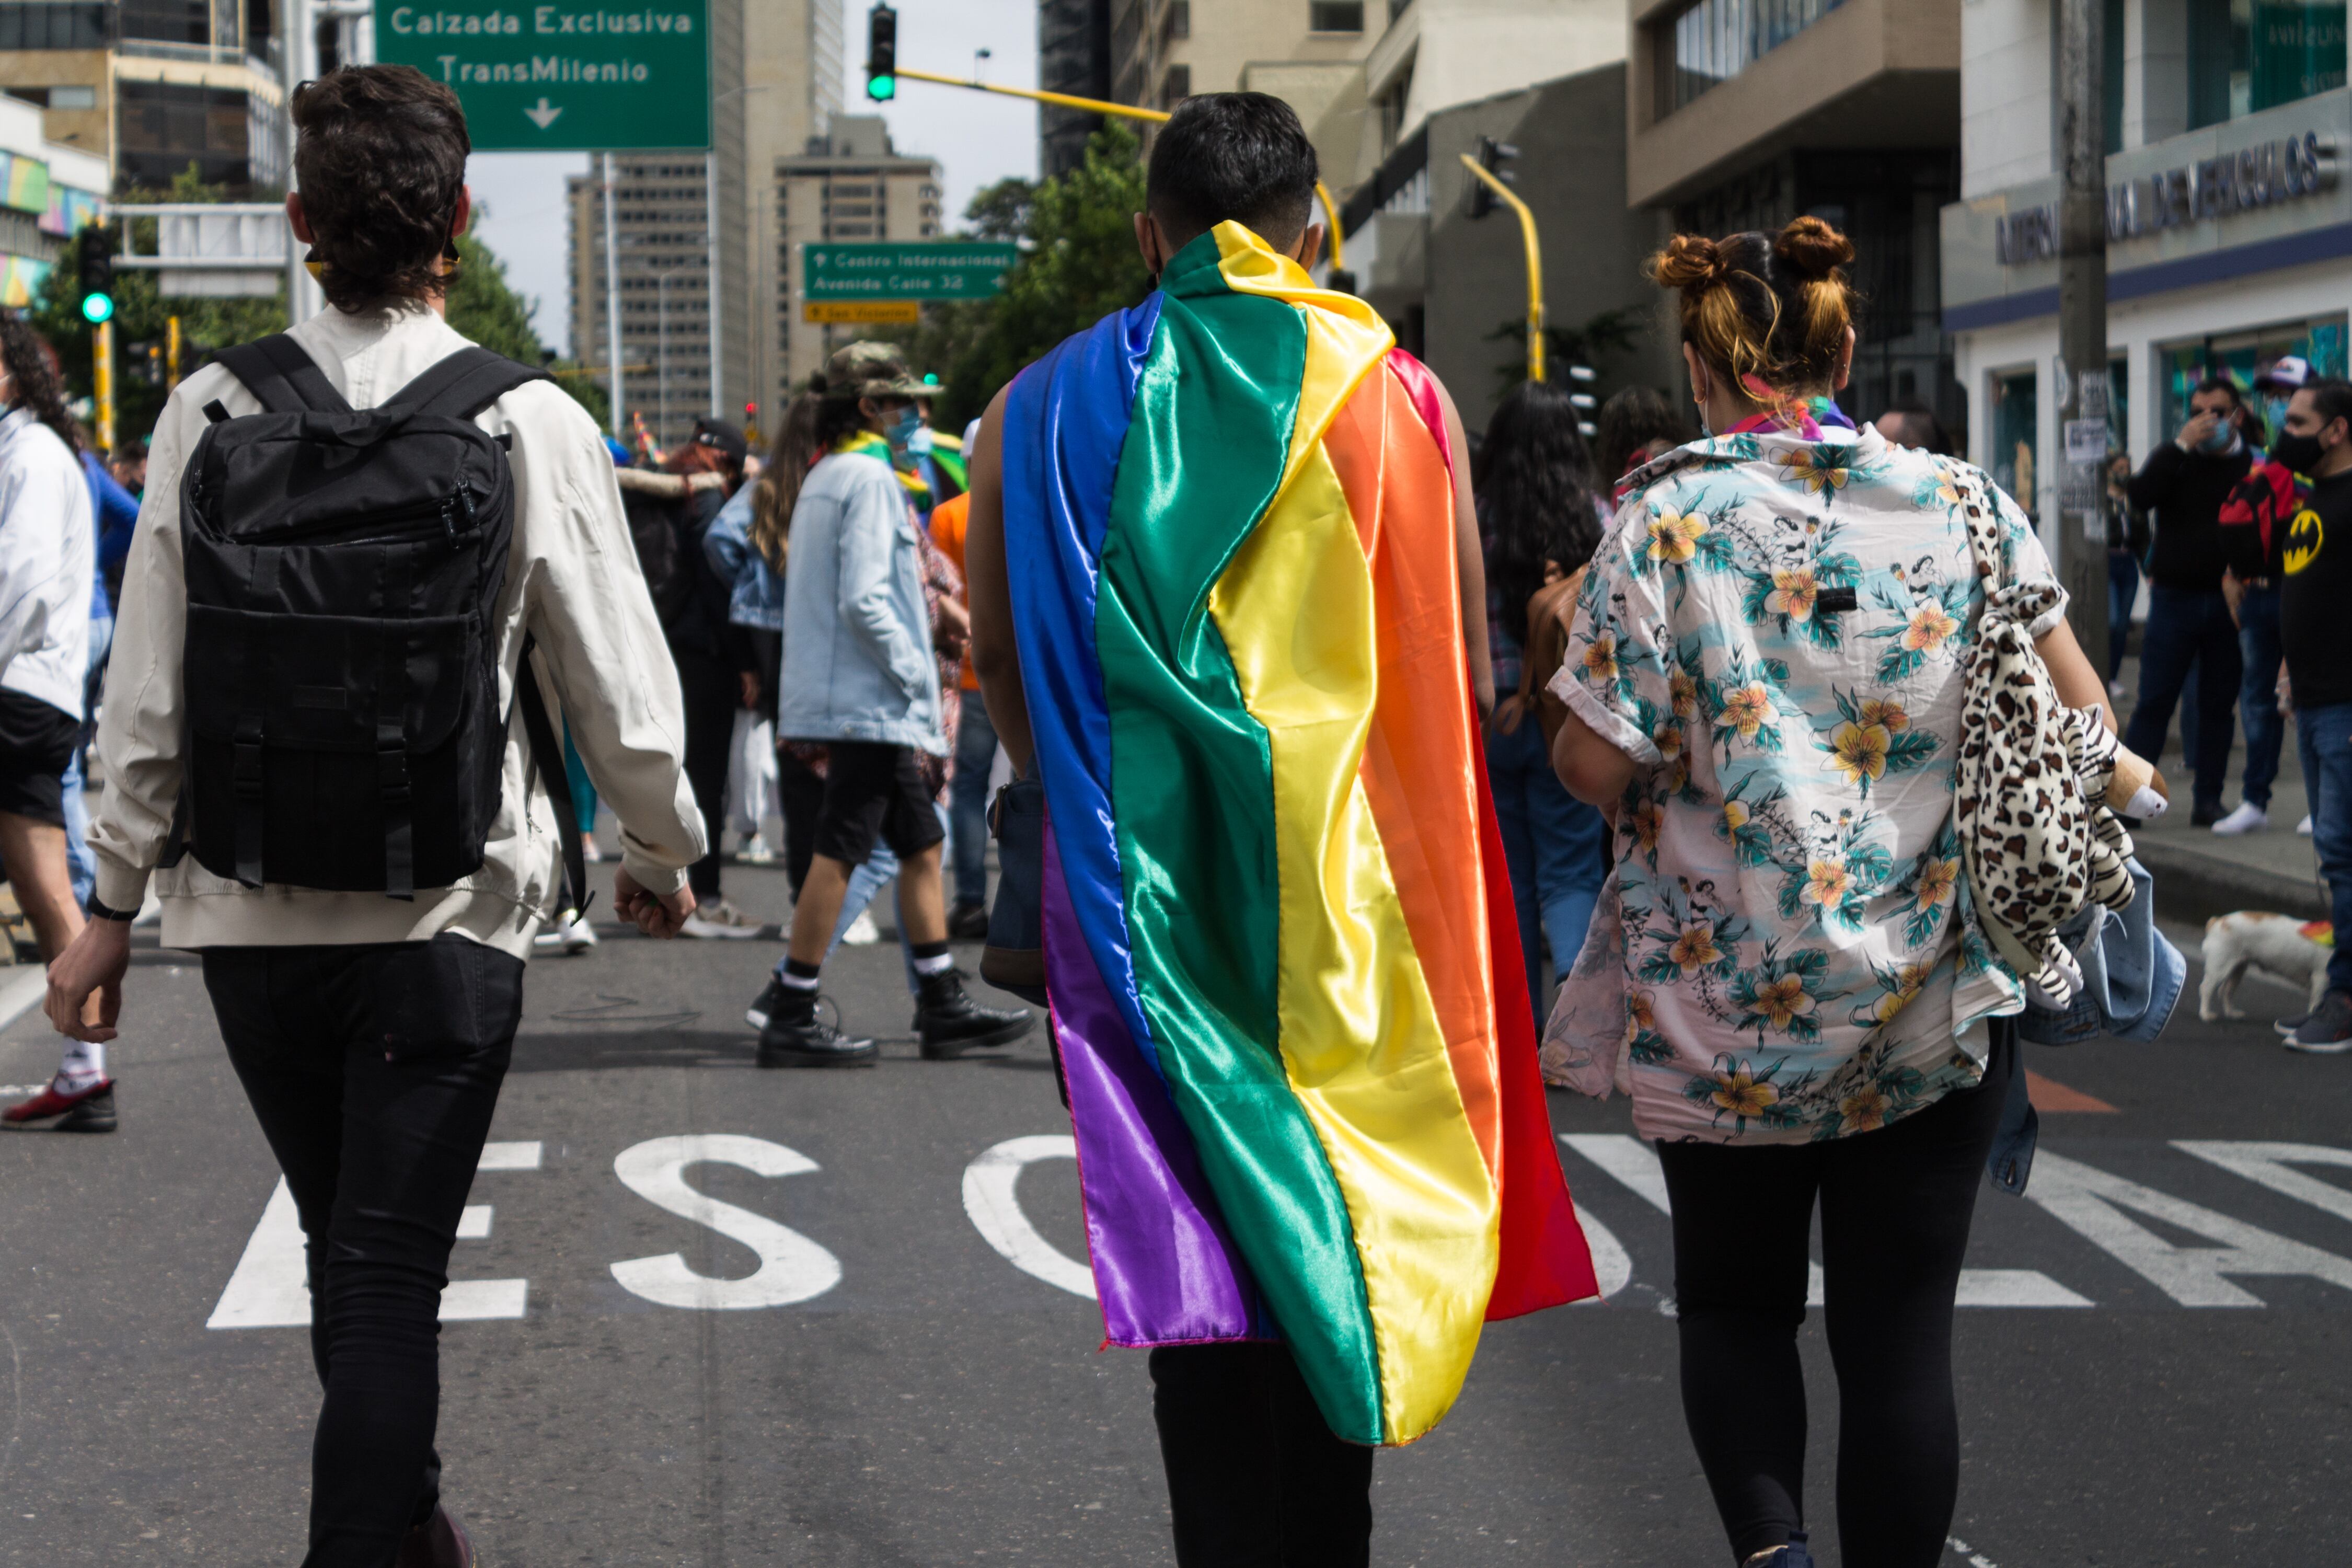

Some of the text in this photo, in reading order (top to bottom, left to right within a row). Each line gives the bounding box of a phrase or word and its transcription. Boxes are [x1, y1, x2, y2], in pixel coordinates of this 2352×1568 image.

[391, 6, 693, 34] Calzada Exclusiva
[436, 55, 649, 82] TransMilenio
